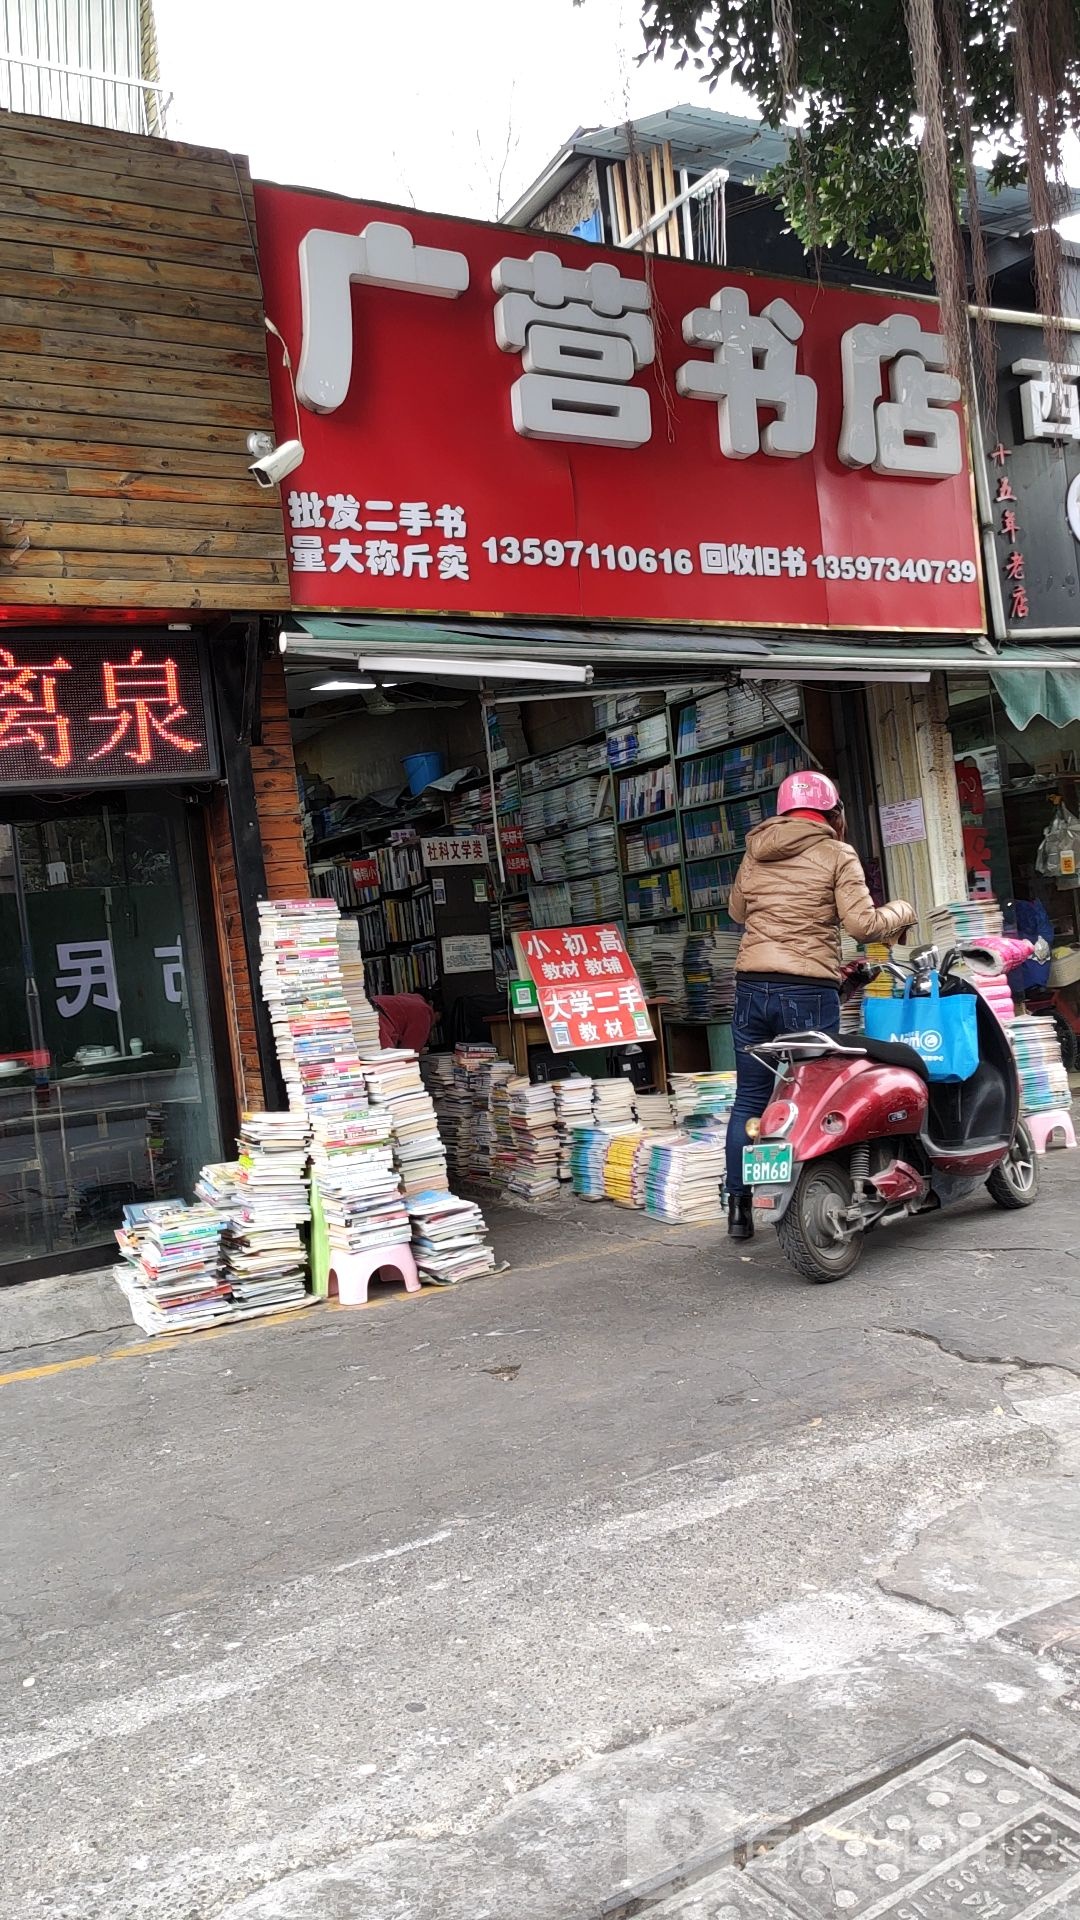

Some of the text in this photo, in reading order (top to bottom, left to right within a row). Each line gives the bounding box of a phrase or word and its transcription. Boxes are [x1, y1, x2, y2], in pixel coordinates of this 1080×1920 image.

[295, 221, 962, 480] 广营书店
[288, 491, 467, 539] 批发二手书
[989, 442, 1029, 618] 十五年老店
[289, 535, 470, 581] 量大称斤卖
[481, 536, 977, 583] 13597110616 回收旧书 13597340739
[427, 840, 483, 862] 社科文学类
[527, 929, 623, 960] 小、初、高
[541, 956, 624, 980] 教材 教辅
[544, 985, 642, 1020] 大学二手
[744, 1161, 789, 1182] F8M68
